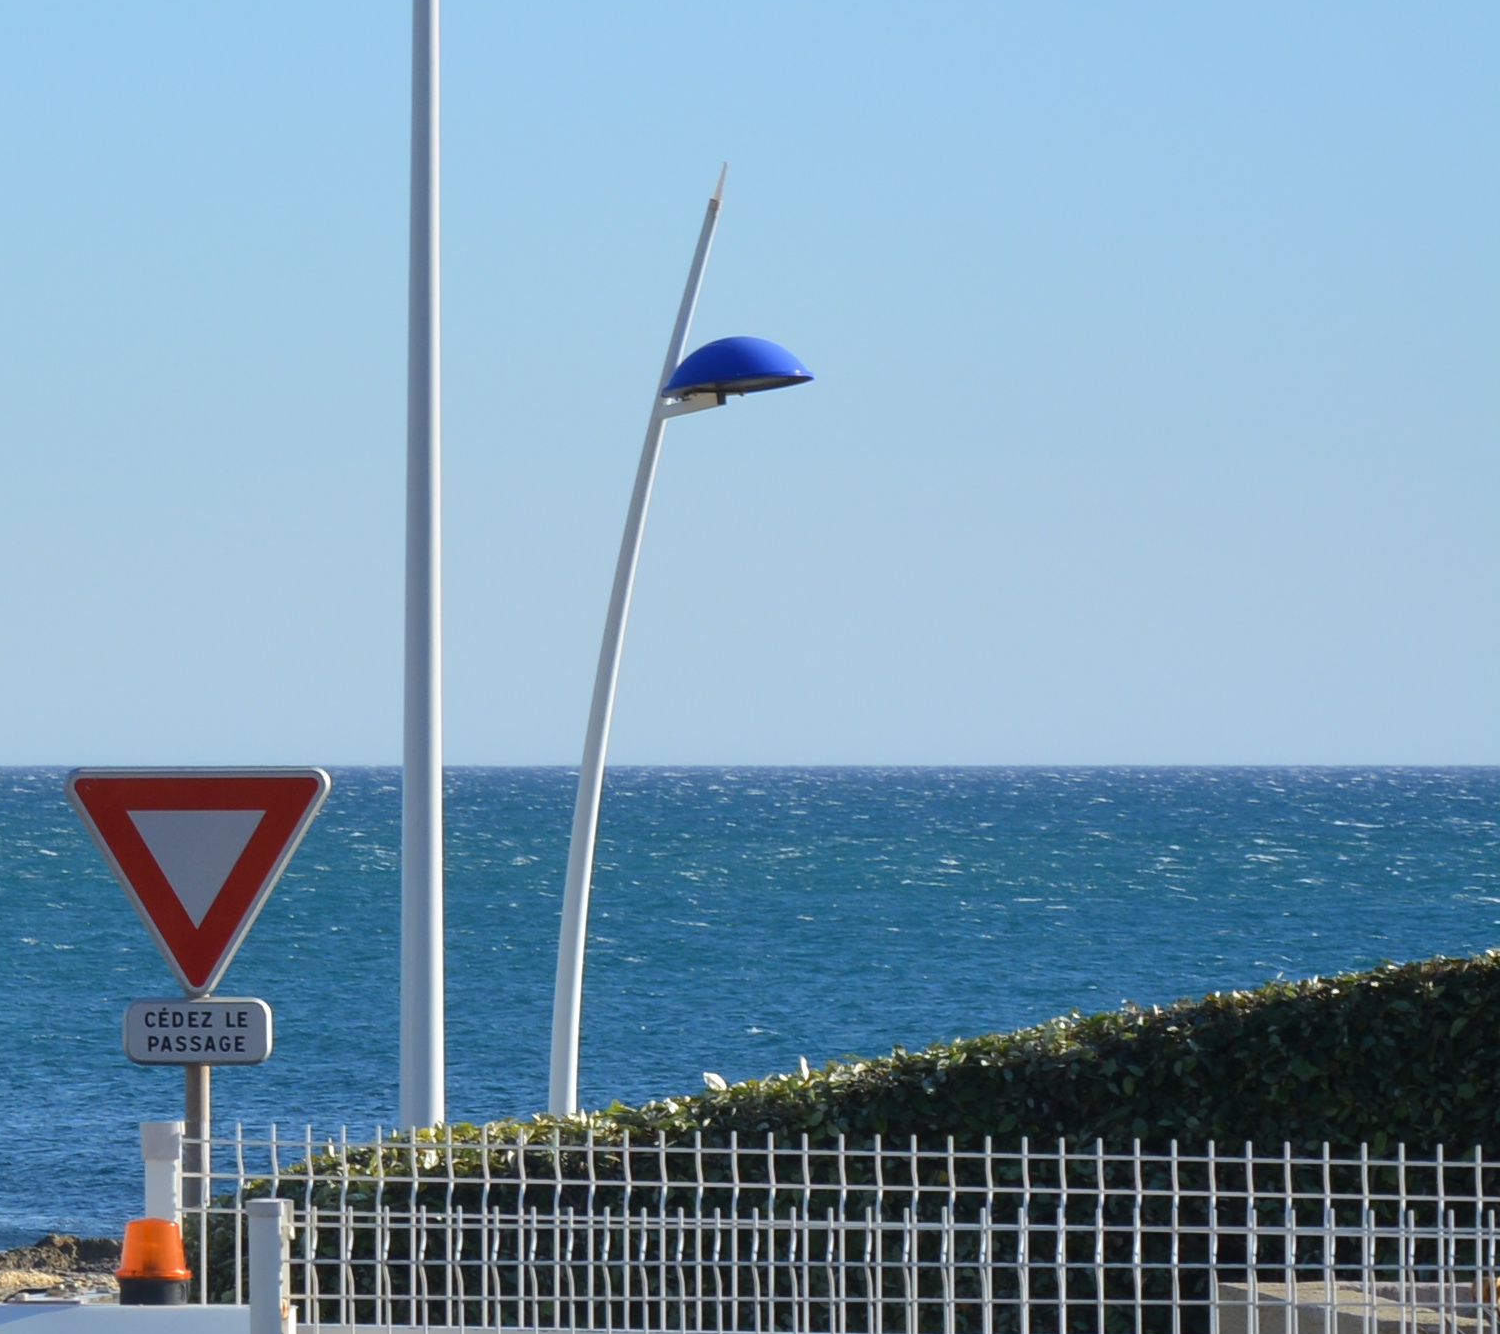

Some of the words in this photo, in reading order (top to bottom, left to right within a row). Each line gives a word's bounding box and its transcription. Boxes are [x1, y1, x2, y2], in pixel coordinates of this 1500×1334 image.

[144, 1007, 213, 1028] CÉDEZ
[225, 1011, 249, 1028] LE
[147, 1035, 246, 1053] PASSAGE
